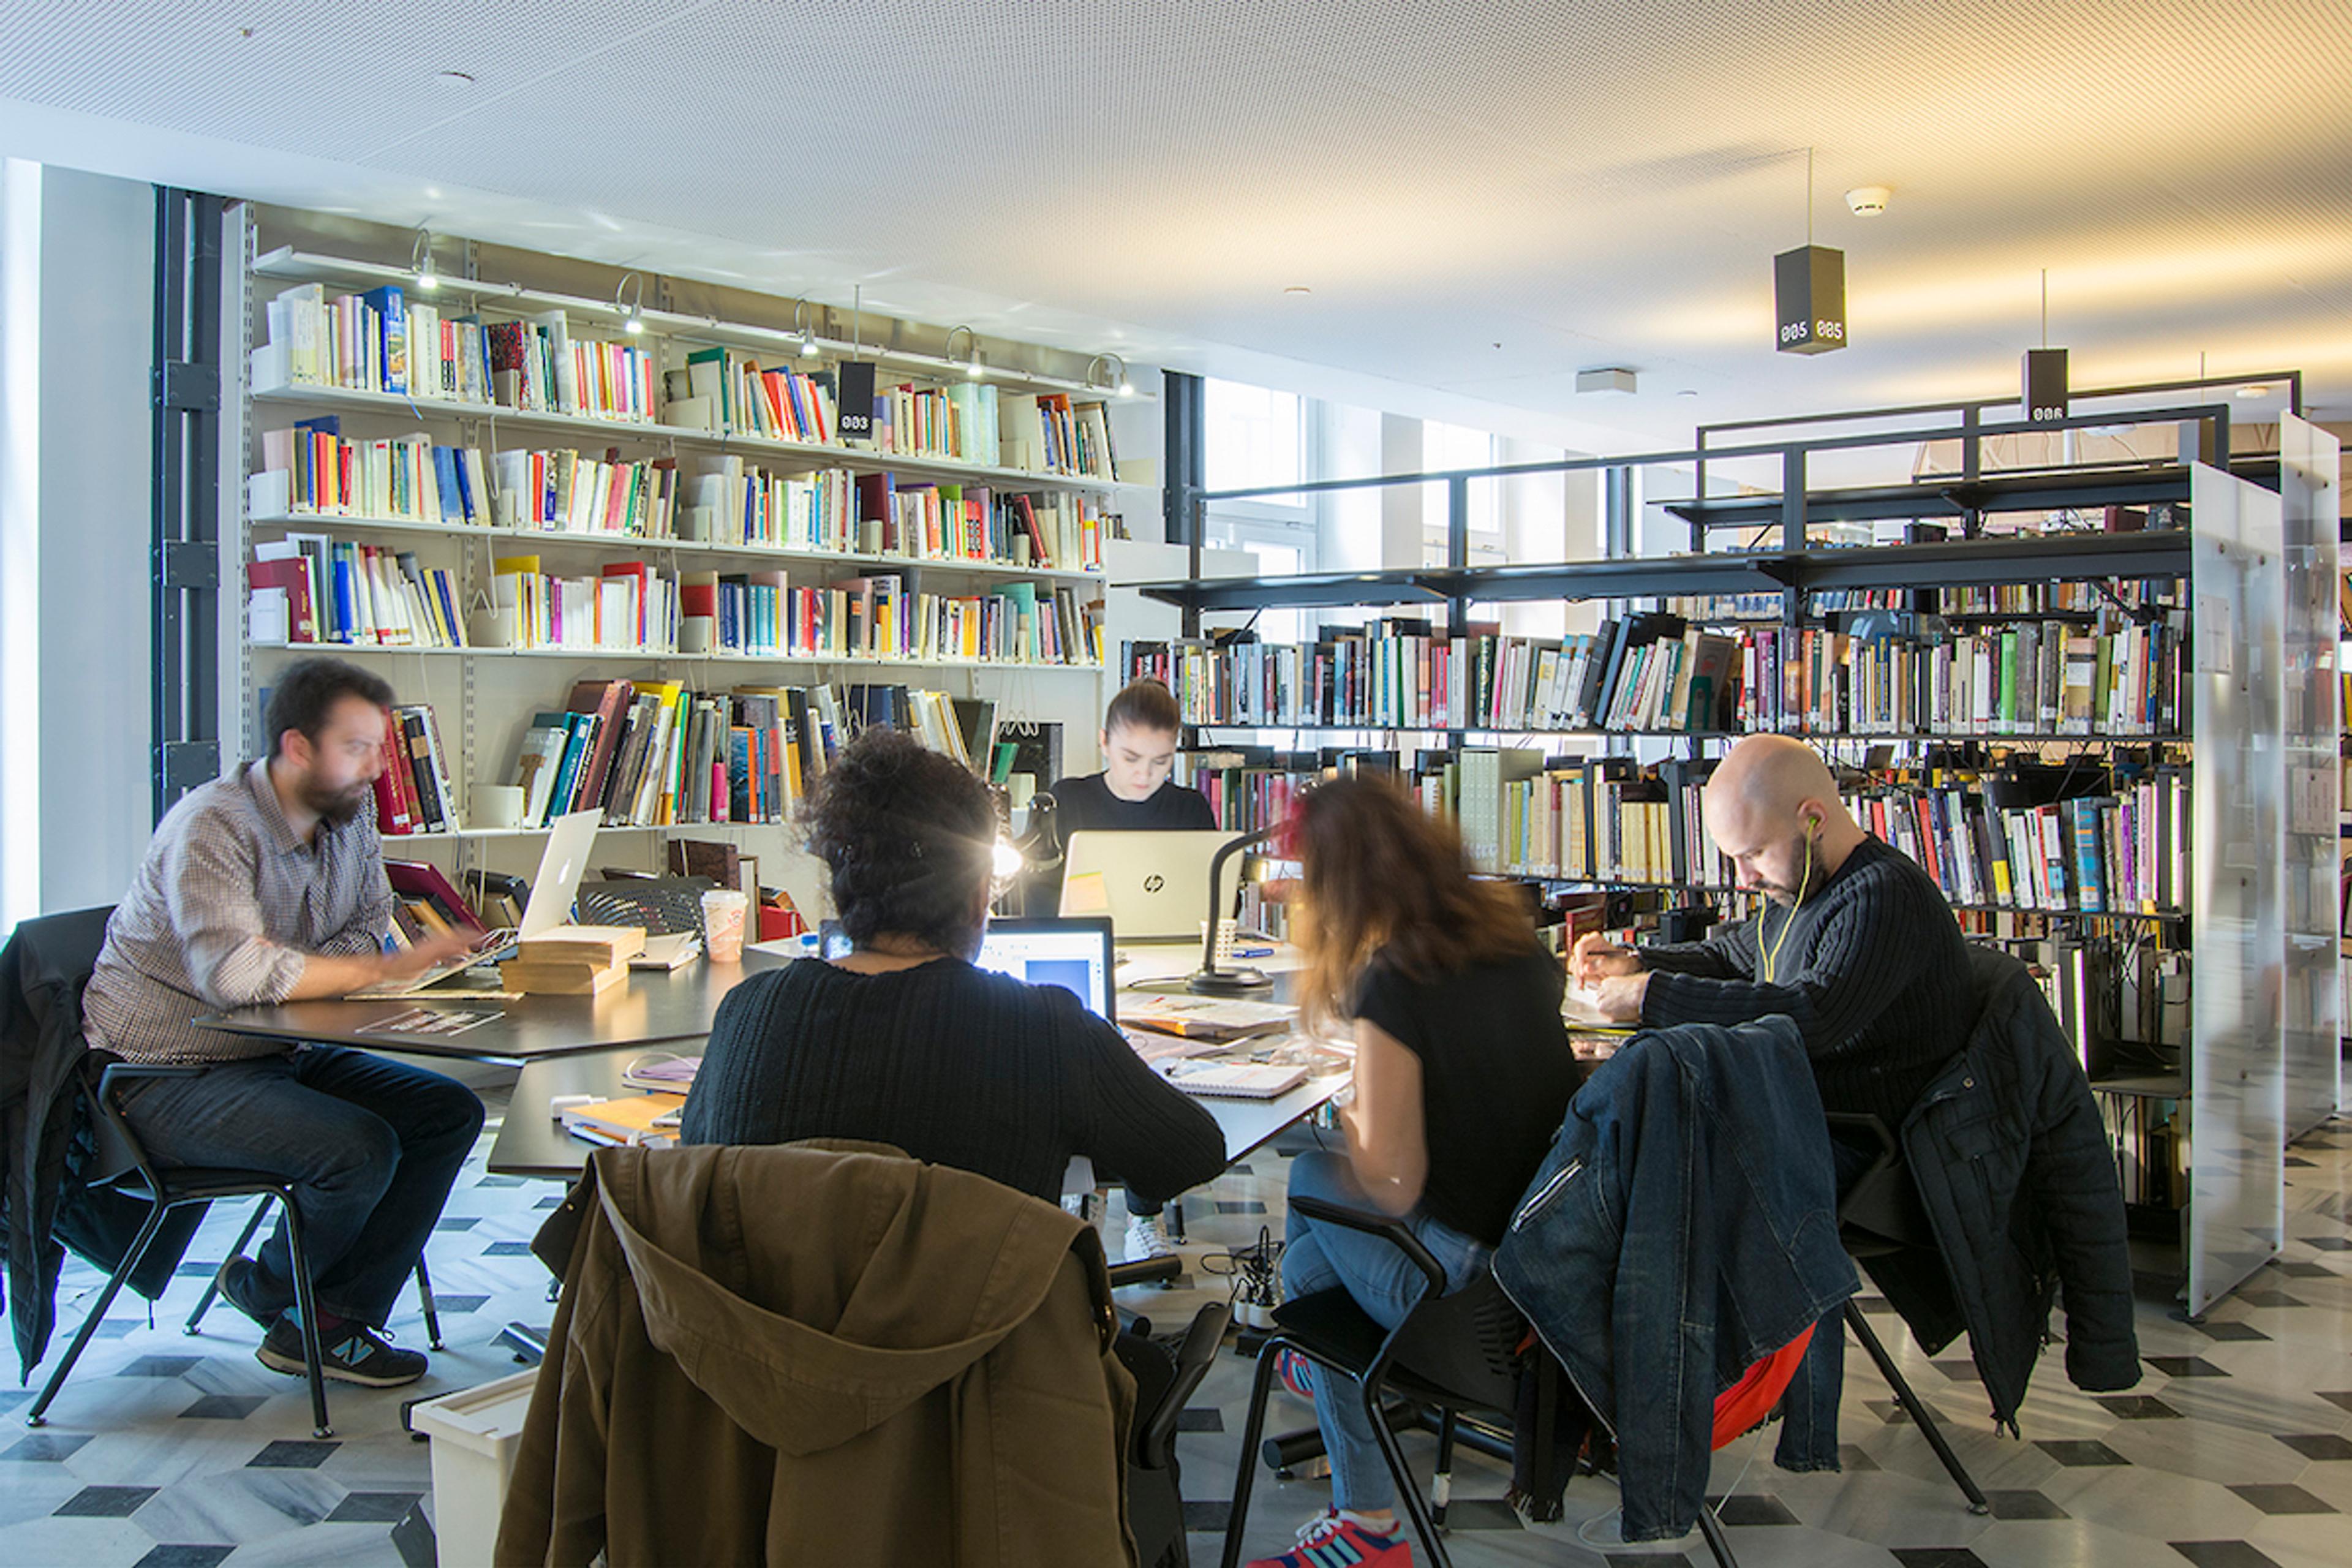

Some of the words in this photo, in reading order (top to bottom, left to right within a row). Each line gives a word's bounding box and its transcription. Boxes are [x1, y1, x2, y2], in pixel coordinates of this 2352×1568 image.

[1781, 320, 1808, 342] 005
[1816, 319, 1844, 341] 005
[842, 415, 869, 430] 003
[331, 1335, 375, 1366] N
